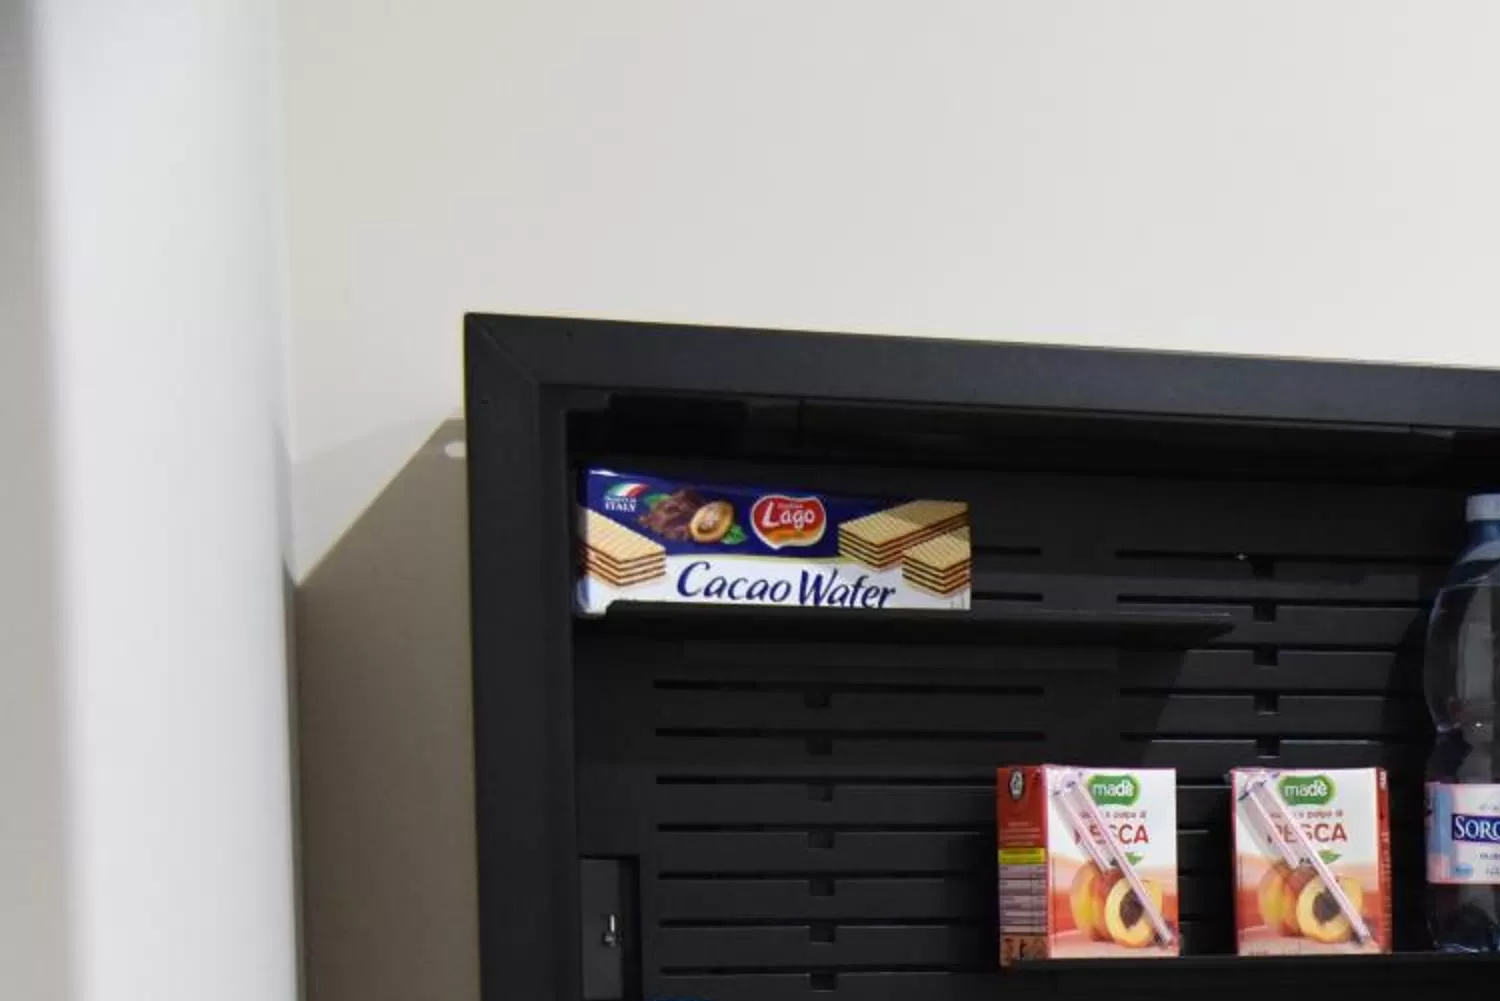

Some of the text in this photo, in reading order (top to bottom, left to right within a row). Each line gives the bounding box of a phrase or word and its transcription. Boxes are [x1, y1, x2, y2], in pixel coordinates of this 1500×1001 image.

[604, 502, 637, 513] ITALY
[762, 501, 815, 529] Lago
[677, 561, 897, 609] Cacao Wafer
